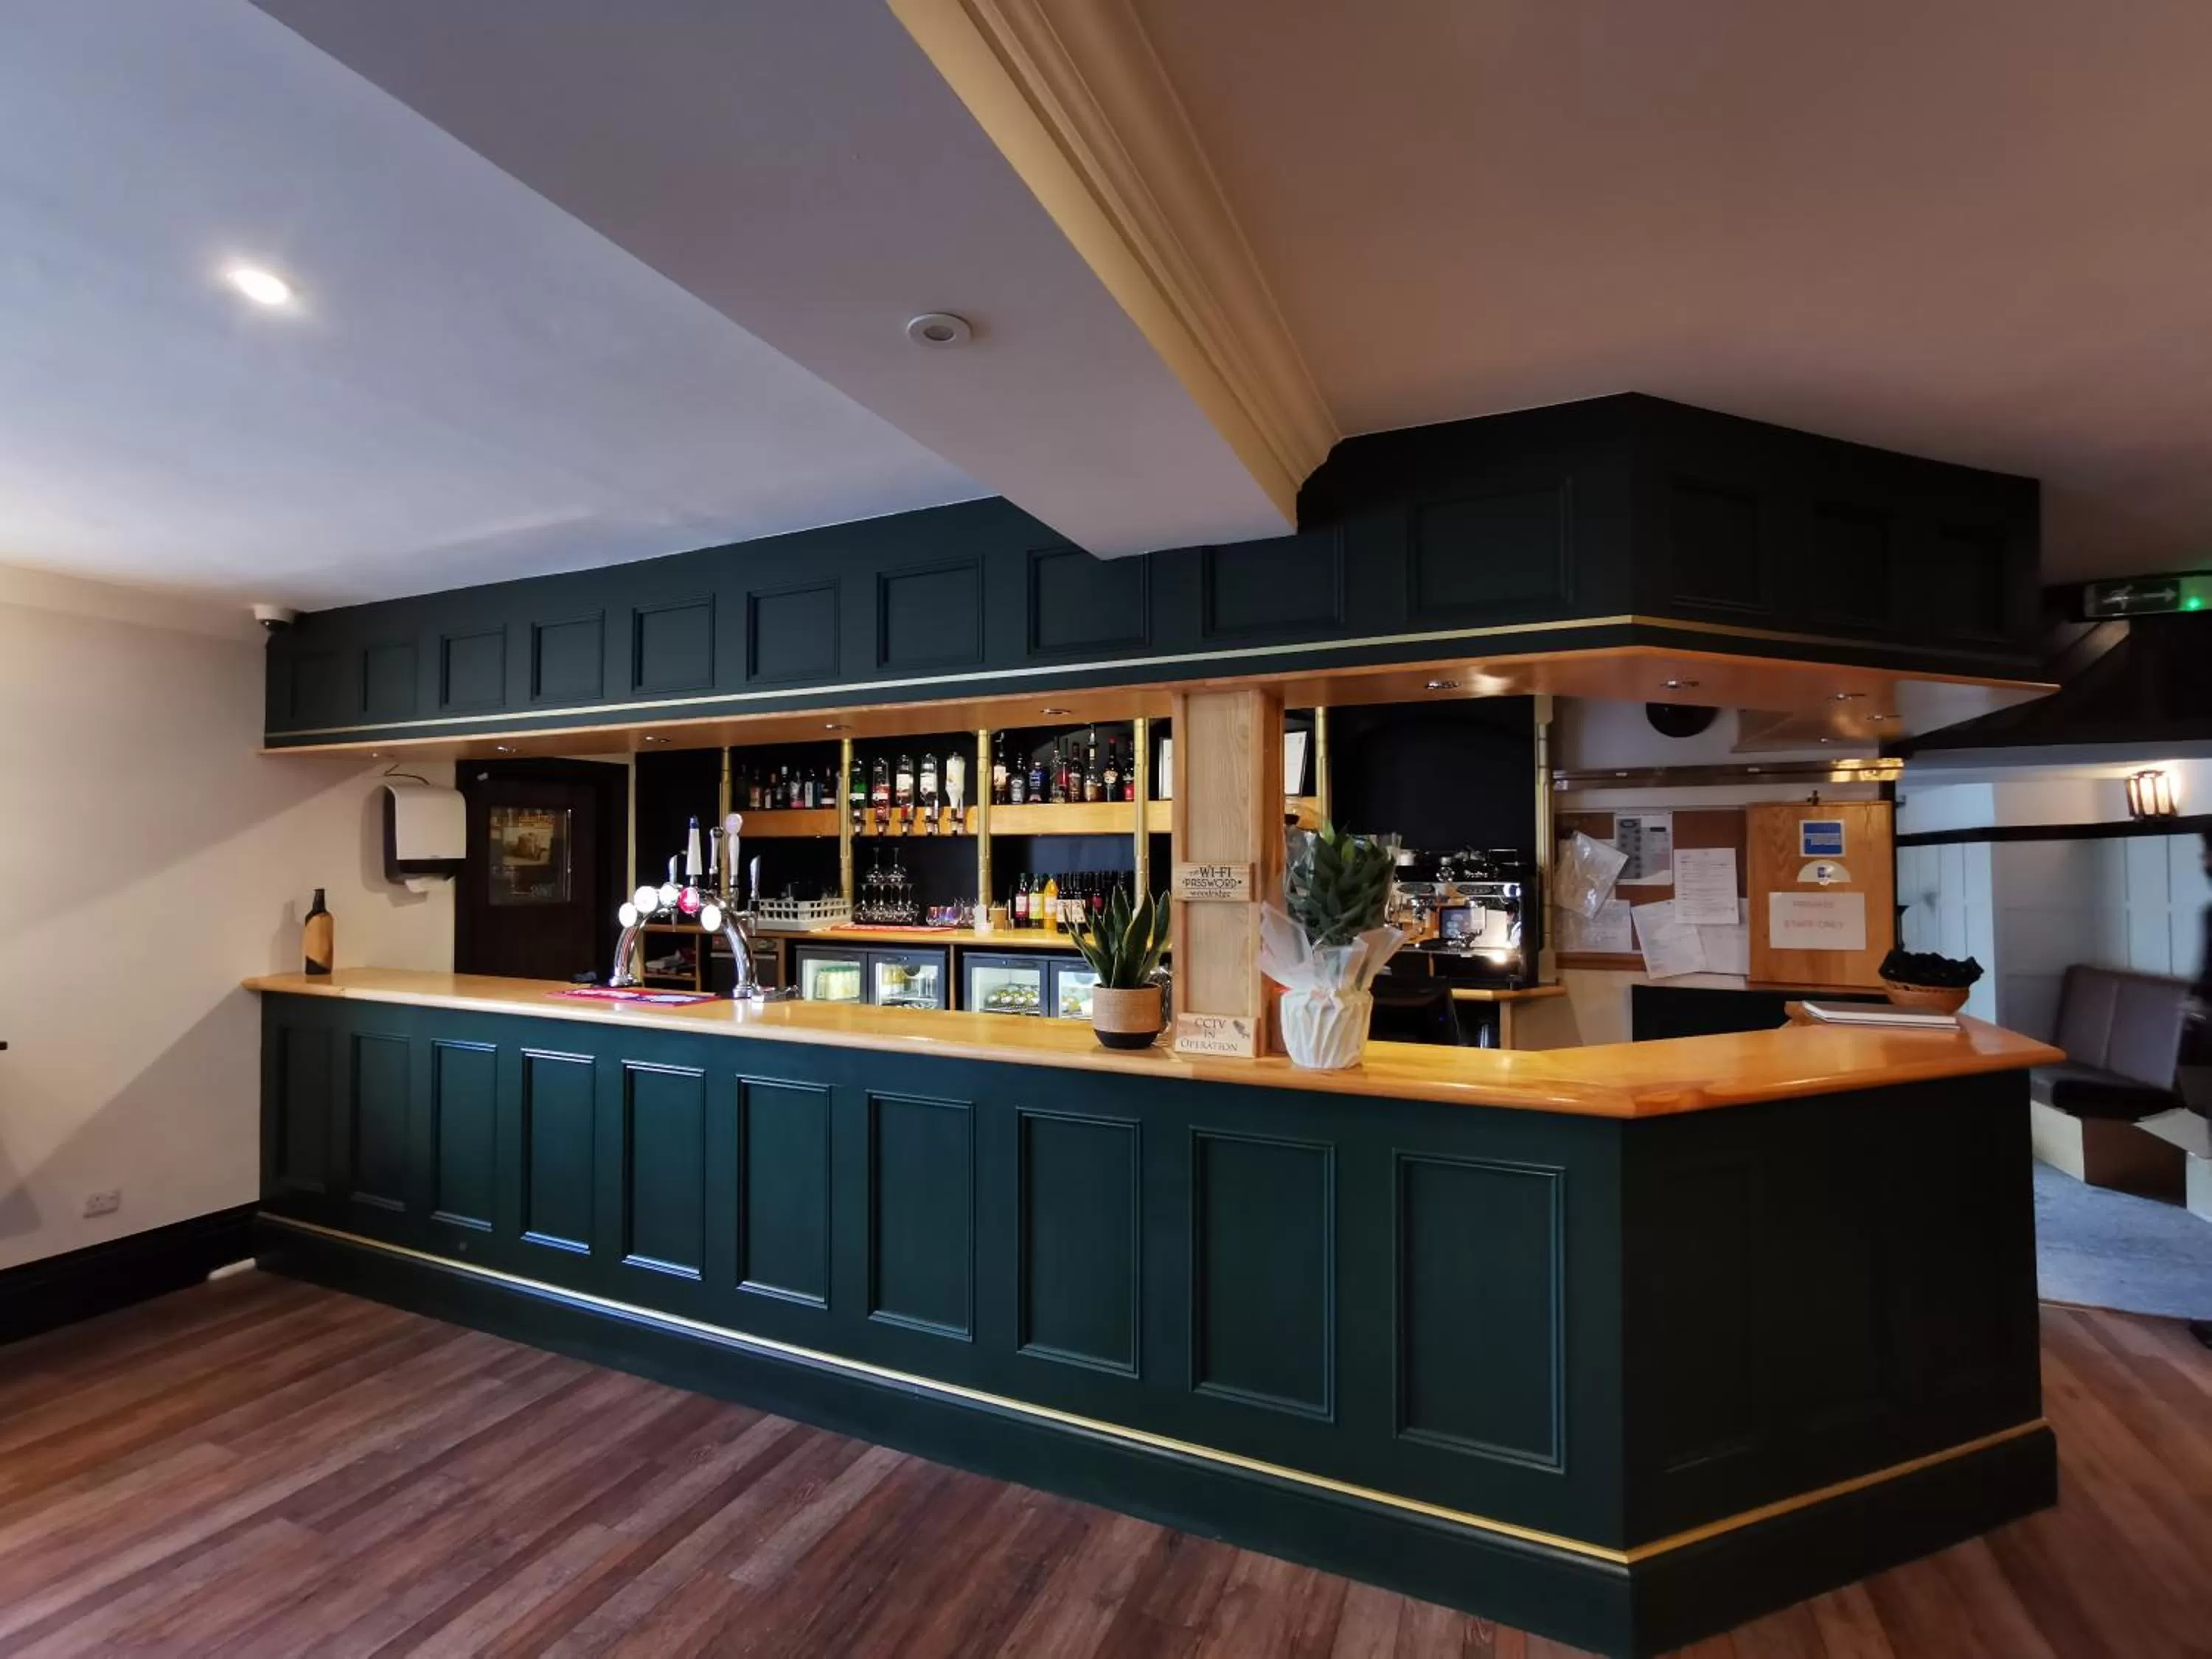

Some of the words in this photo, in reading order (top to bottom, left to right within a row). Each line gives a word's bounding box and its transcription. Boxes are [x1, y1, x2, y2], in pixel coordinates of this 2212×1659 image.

[1200, 867, 1231, 878] WI-FI
[1194, 1018, 1226, 1029] CCTV
[1204, 1029, 1216, 1039] IN
